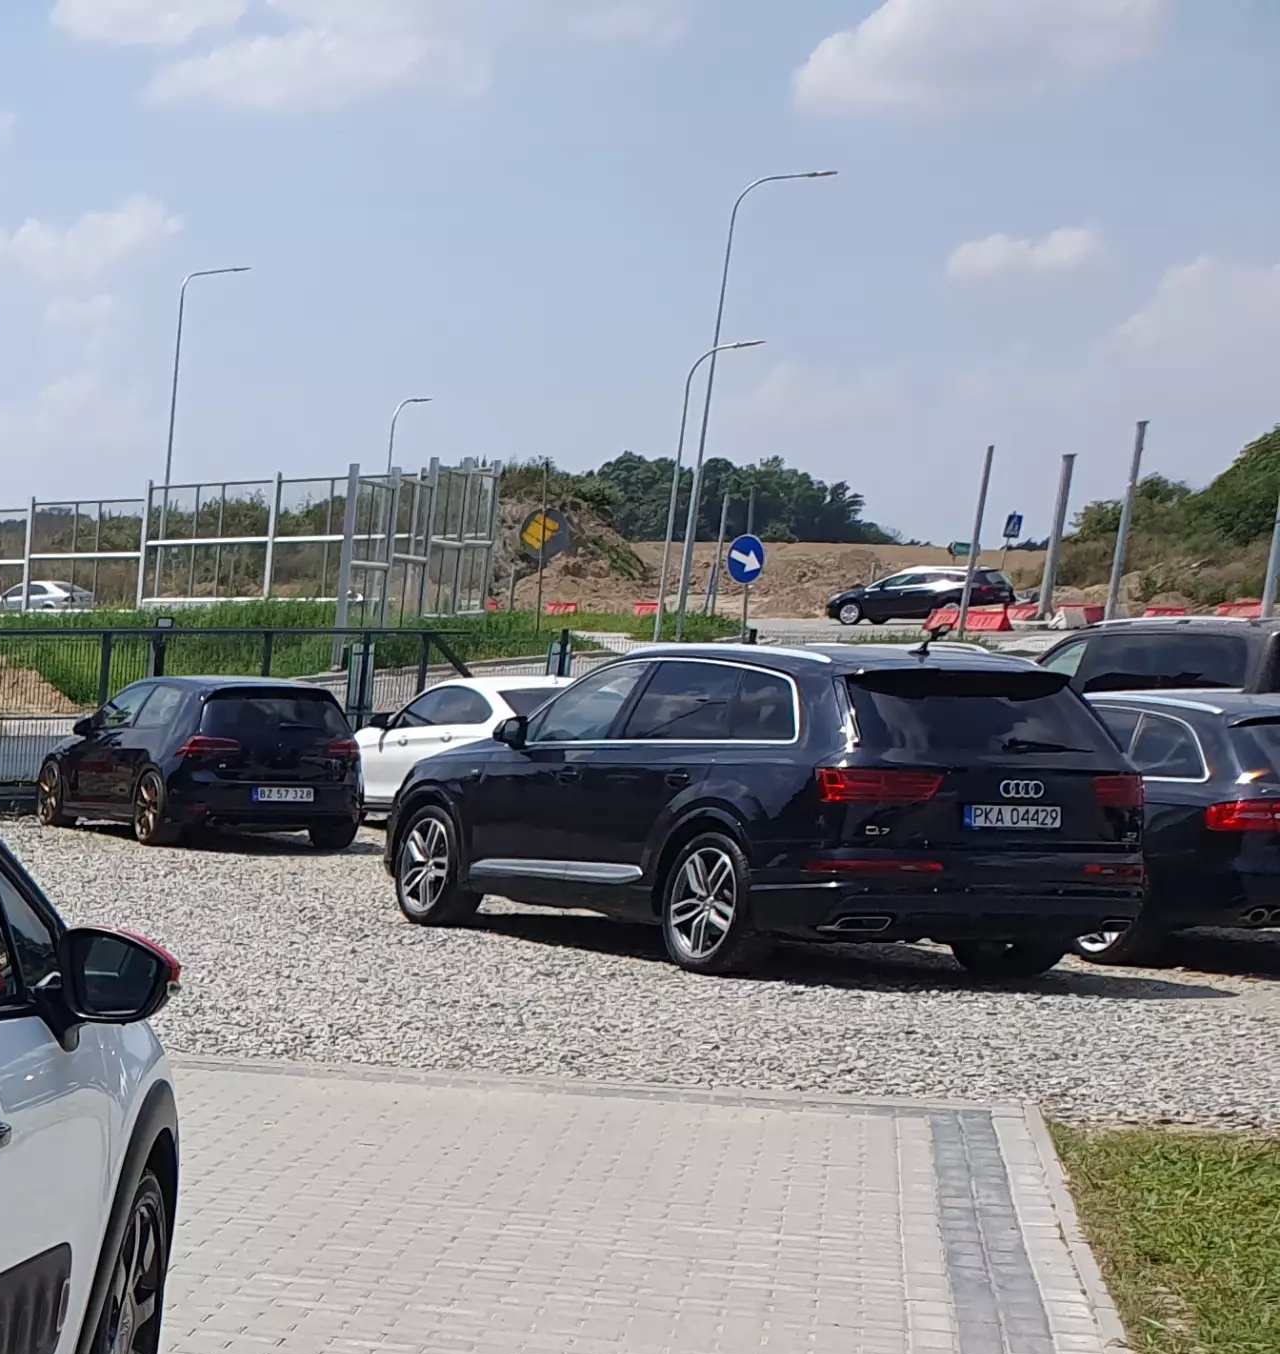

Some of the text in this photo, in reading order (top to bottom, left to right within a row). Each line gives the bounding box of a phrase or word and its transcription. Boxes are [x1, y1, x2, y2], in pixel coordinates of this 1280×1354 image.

[973, 807, 1059, 826] PKA 04429
[865, 825, 890, 835] Q7
